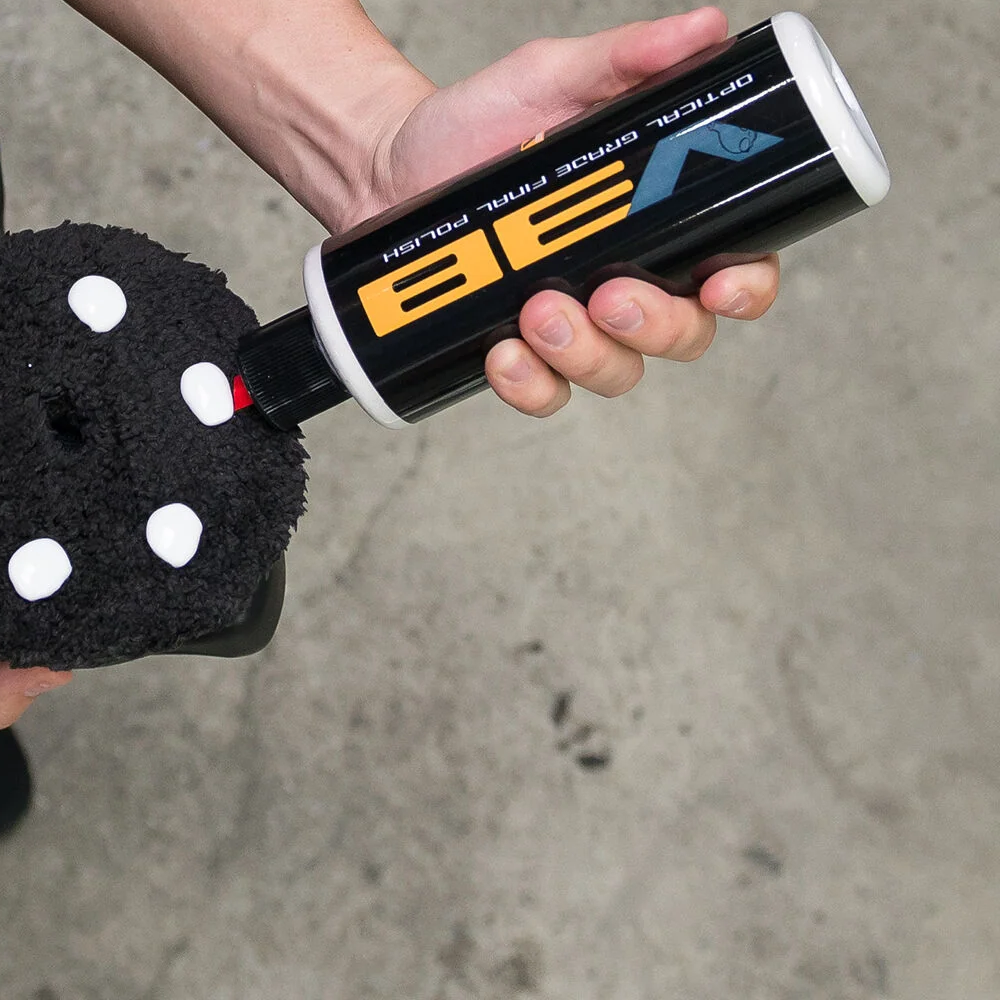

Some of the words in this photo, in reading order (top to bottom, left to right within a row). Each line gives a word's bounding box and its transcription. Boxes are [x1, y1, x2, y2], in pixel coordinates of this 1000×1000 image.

[645, 72, 754, 129] OPTICAL
[554, 129, 639, 178] GRADE
[475, 175, 548, 214] FINAL
[380, 213, 469, 265] POLISH
